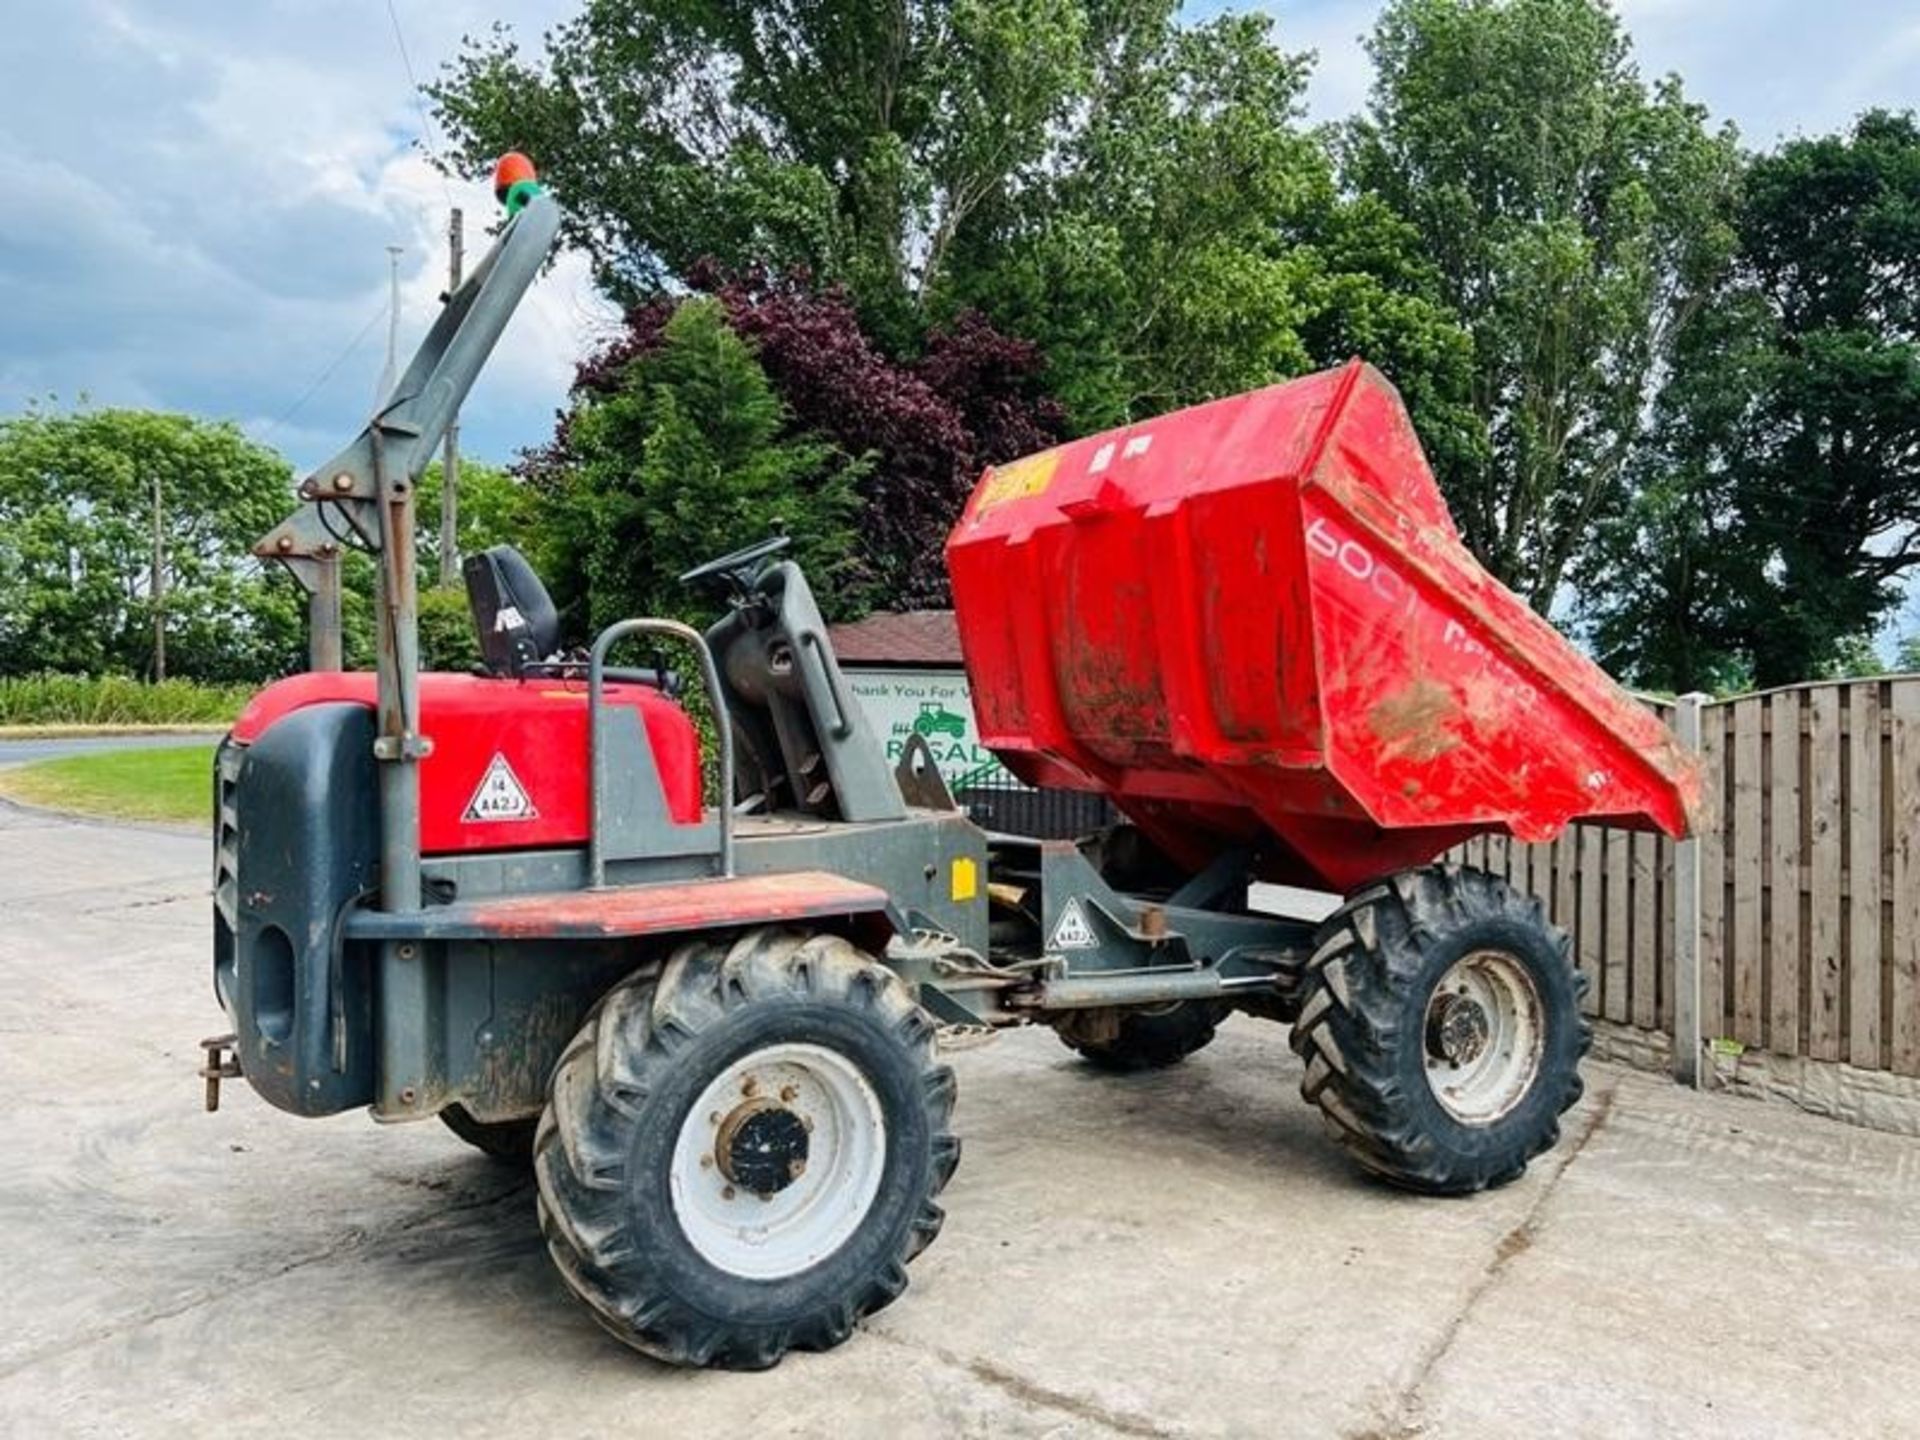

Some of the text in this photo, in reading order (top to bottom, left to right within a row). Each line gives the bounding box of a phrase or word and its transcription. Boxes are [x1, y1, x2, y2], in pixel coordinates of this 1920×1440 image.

[851, 684, 889, 697] hank
[894, 685, 925, 698] You
[931, 686, 957, 699] For
